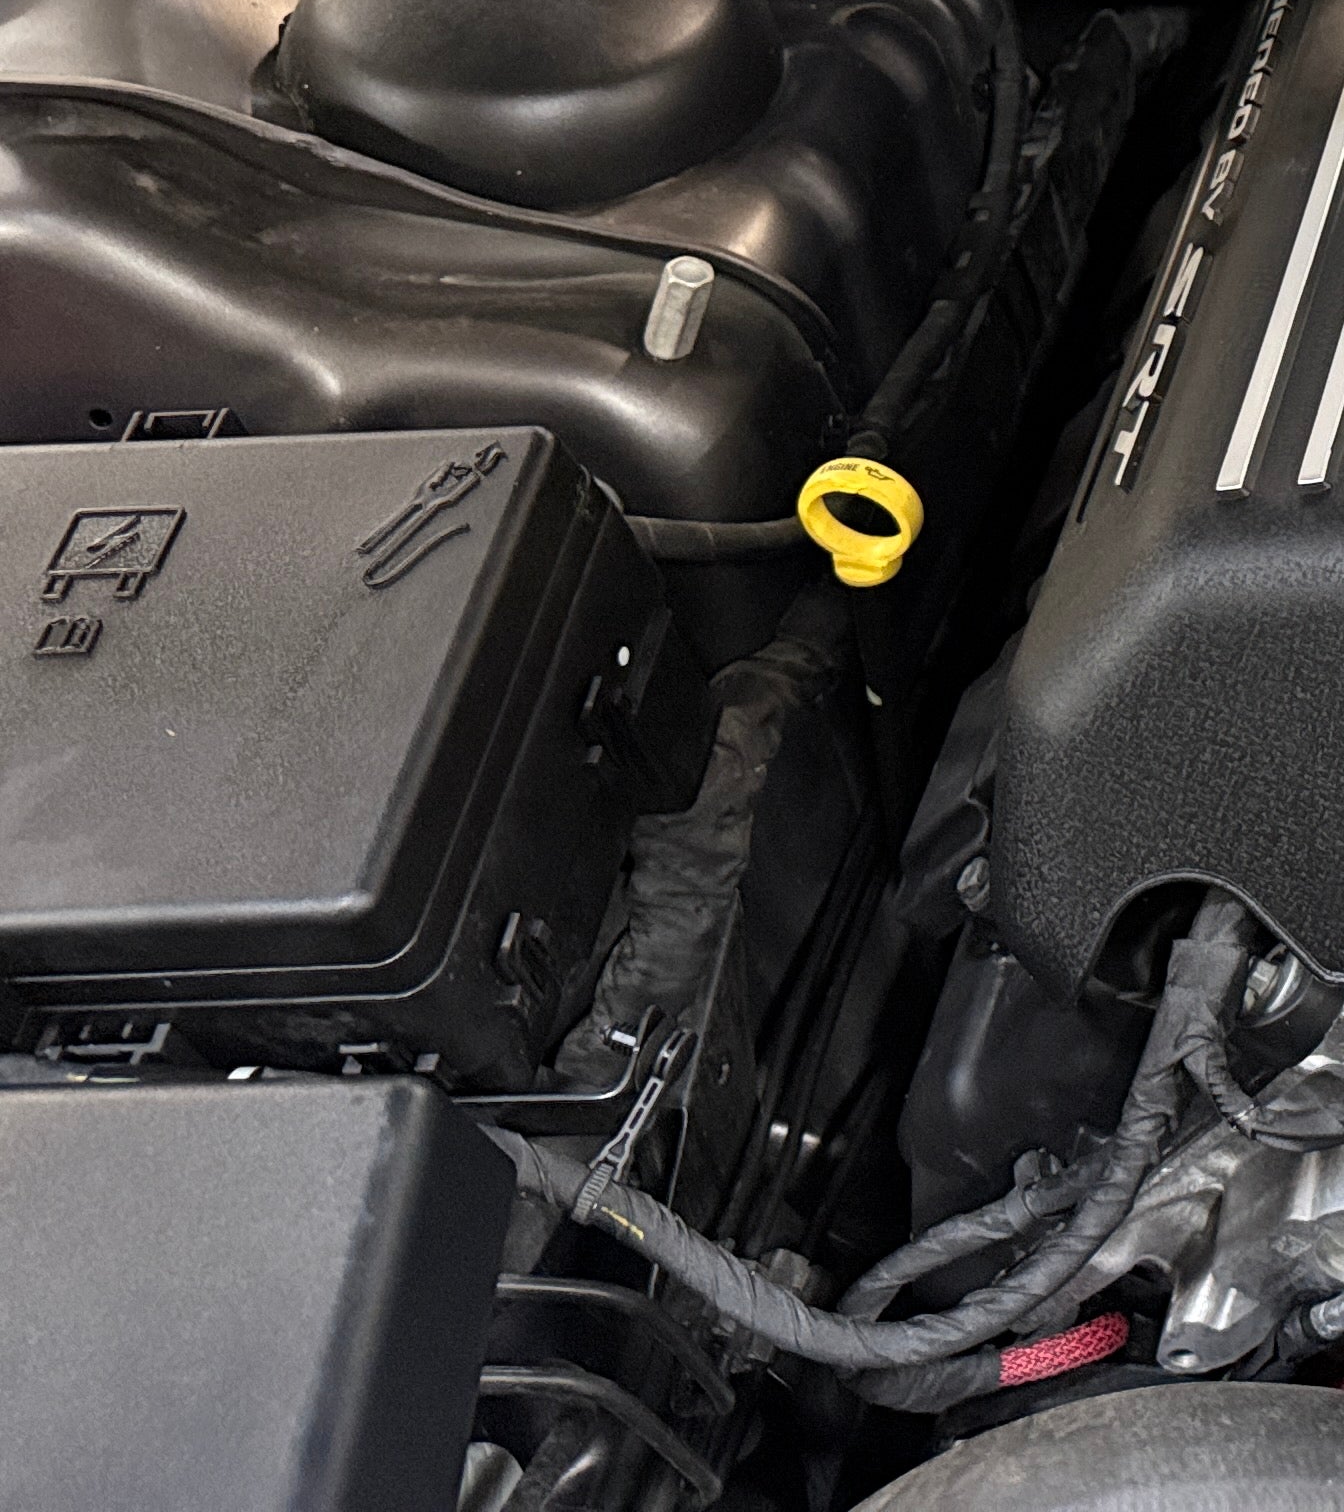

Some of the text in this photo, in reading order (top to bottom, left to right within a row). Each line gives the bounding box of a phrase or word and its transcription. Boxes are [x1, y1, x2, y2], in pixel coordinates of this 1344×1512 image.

[1201, 148, 1237, 221] BY
[1114, 240, 1204, 488] SRT
[820, 463, 860, 475] ENGINE
